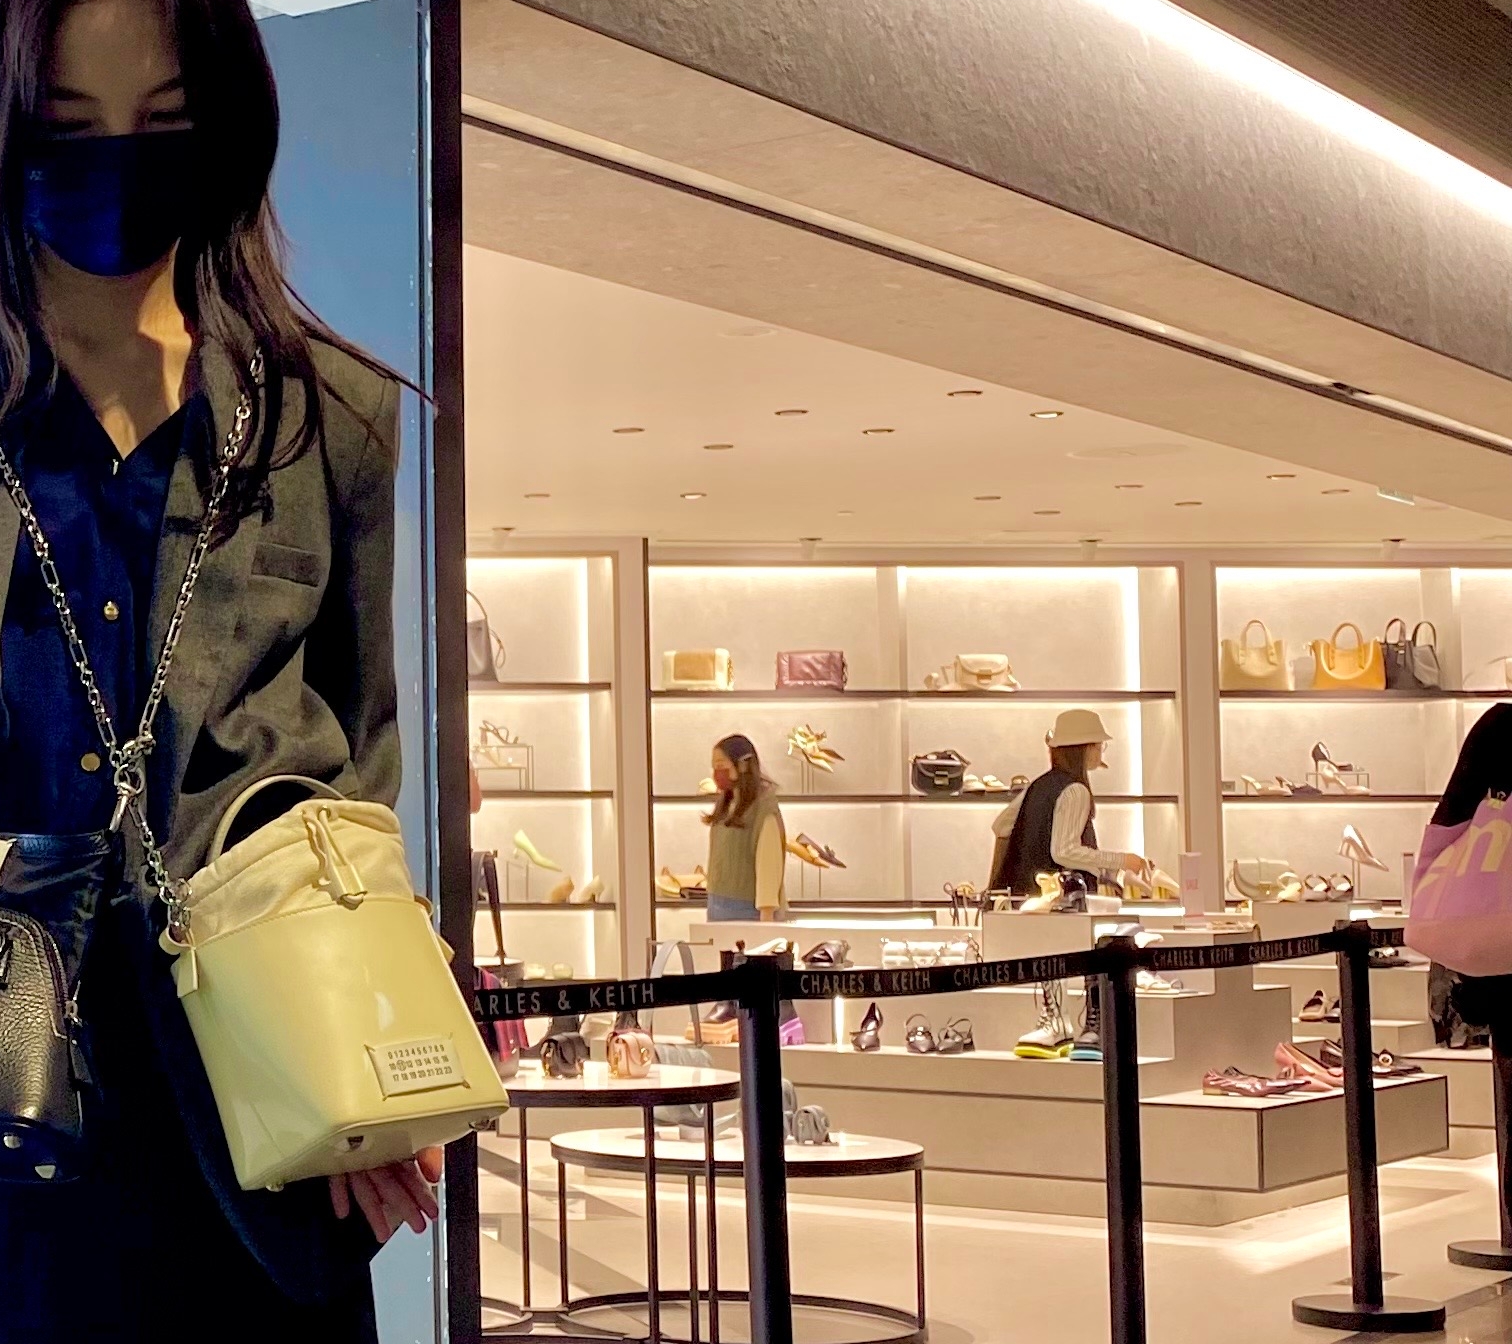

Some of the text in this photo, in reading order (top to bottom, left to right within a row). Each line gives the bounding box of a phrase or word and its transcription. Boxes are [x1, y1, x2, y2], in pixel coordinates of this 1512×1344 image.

[800, 973, 864, 995] CHARLES
[892, 970, 931, 992] KEITH
[953, 964, 1010, 987] CHARLES
[1033, 957, 1067, 978] KEITH
[558, 989, 571, 1011] &
[589, 982, 655, 1008] KEITH
